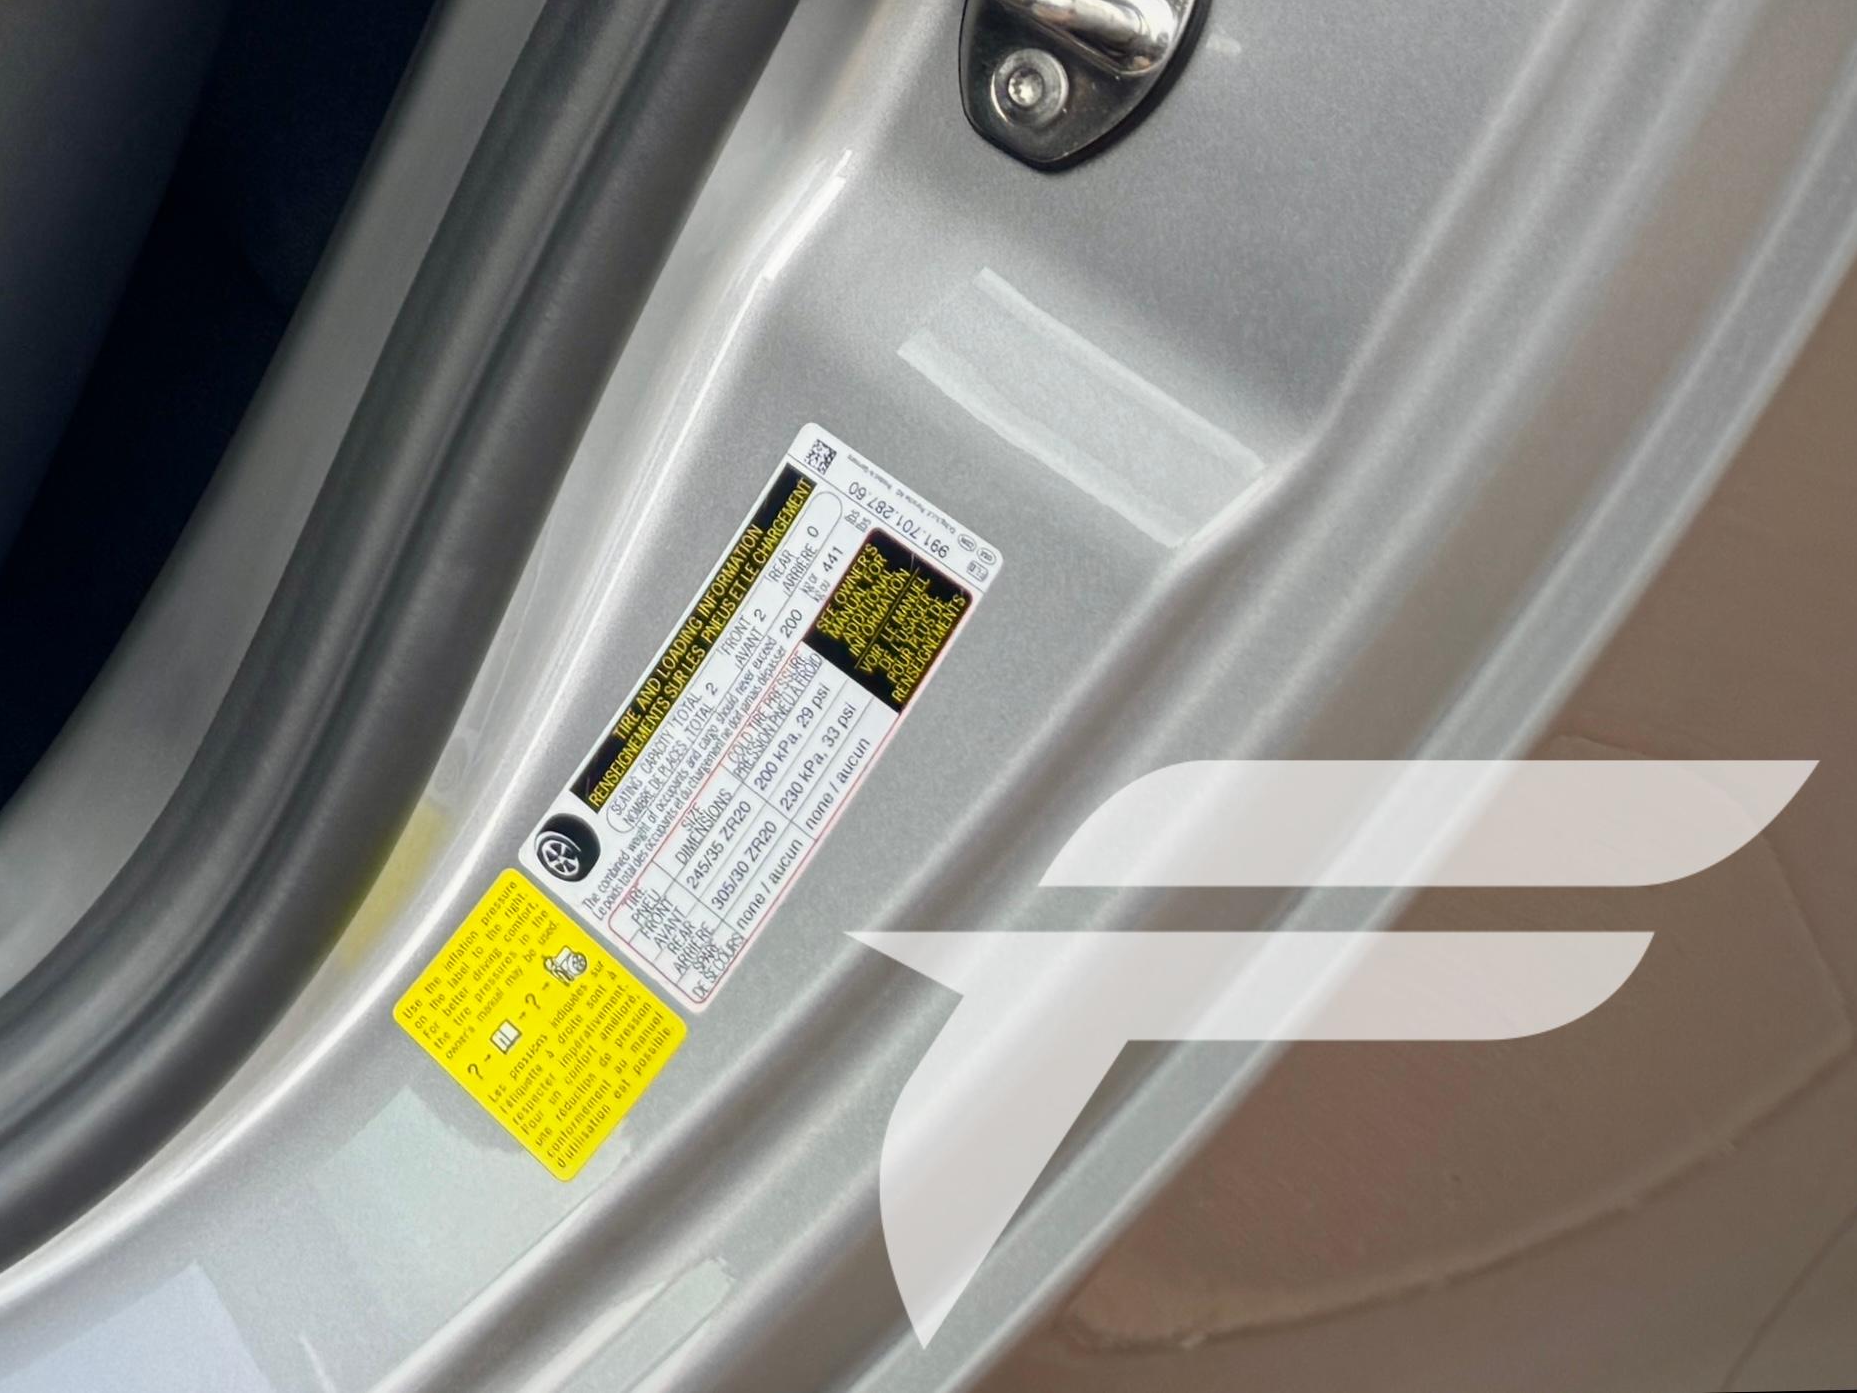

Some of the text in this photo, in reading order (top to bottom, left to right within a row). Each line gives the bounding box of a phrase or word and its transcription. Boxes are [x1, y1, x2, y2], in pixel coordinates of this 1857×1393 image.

[612, 523, 765, 743] TIRE AND LOADING INFORMATION
[814, 541, 879, 632] SEE OWNER'S
[826, 552, 888, 639] MANUAL FOR
[839, 565, 897, 643] ADDITIONAL
[846, 566, 912, 657] INFORMATION
[858, 572, 930, 674] VOIR LE MANUEL
[588, 477, 815, 809] RENSEIGNEMENTS SUR LES PNEUS ET LE CHARGEMENT
[609, 774, 642, 817] SEATING
[637, 727, 674, 775] CAPACITY
[671, 688, 703, 728] TOTAL
[703, 680, 719, 696] 2
[719, 615, 752, 656] FRONT
[752, 607, 767, 622] 2
[767, 548, 796, 583] REAR
[885, 596, 948, 684] POUR PLUS DE
[888, 592, 968, 702] RENSEIGNEMENTS
[726, 650, 808, 765] COLD TIRE PRESSURE
[752, 681, 833, 792] 200 kPa, 29 psi
[777, 701, 858, 812] 230 kPa, 33 psi
[803, 735, 871, 831] none / aucun
[674, 785, 734, 867] DIMENSIONS
[685, 797, 752, 891] 245/35 ZR20
[709, 817, 778, 912] 305/30 ZR20
[630, 886, 662, 927] PNEU
[639, 894, 675, 941] FRONT
[651, 905, 687, 951] AVANT
[735, 836, 803, 932] none / aucun
[666, 918, 696, 956] REAR
